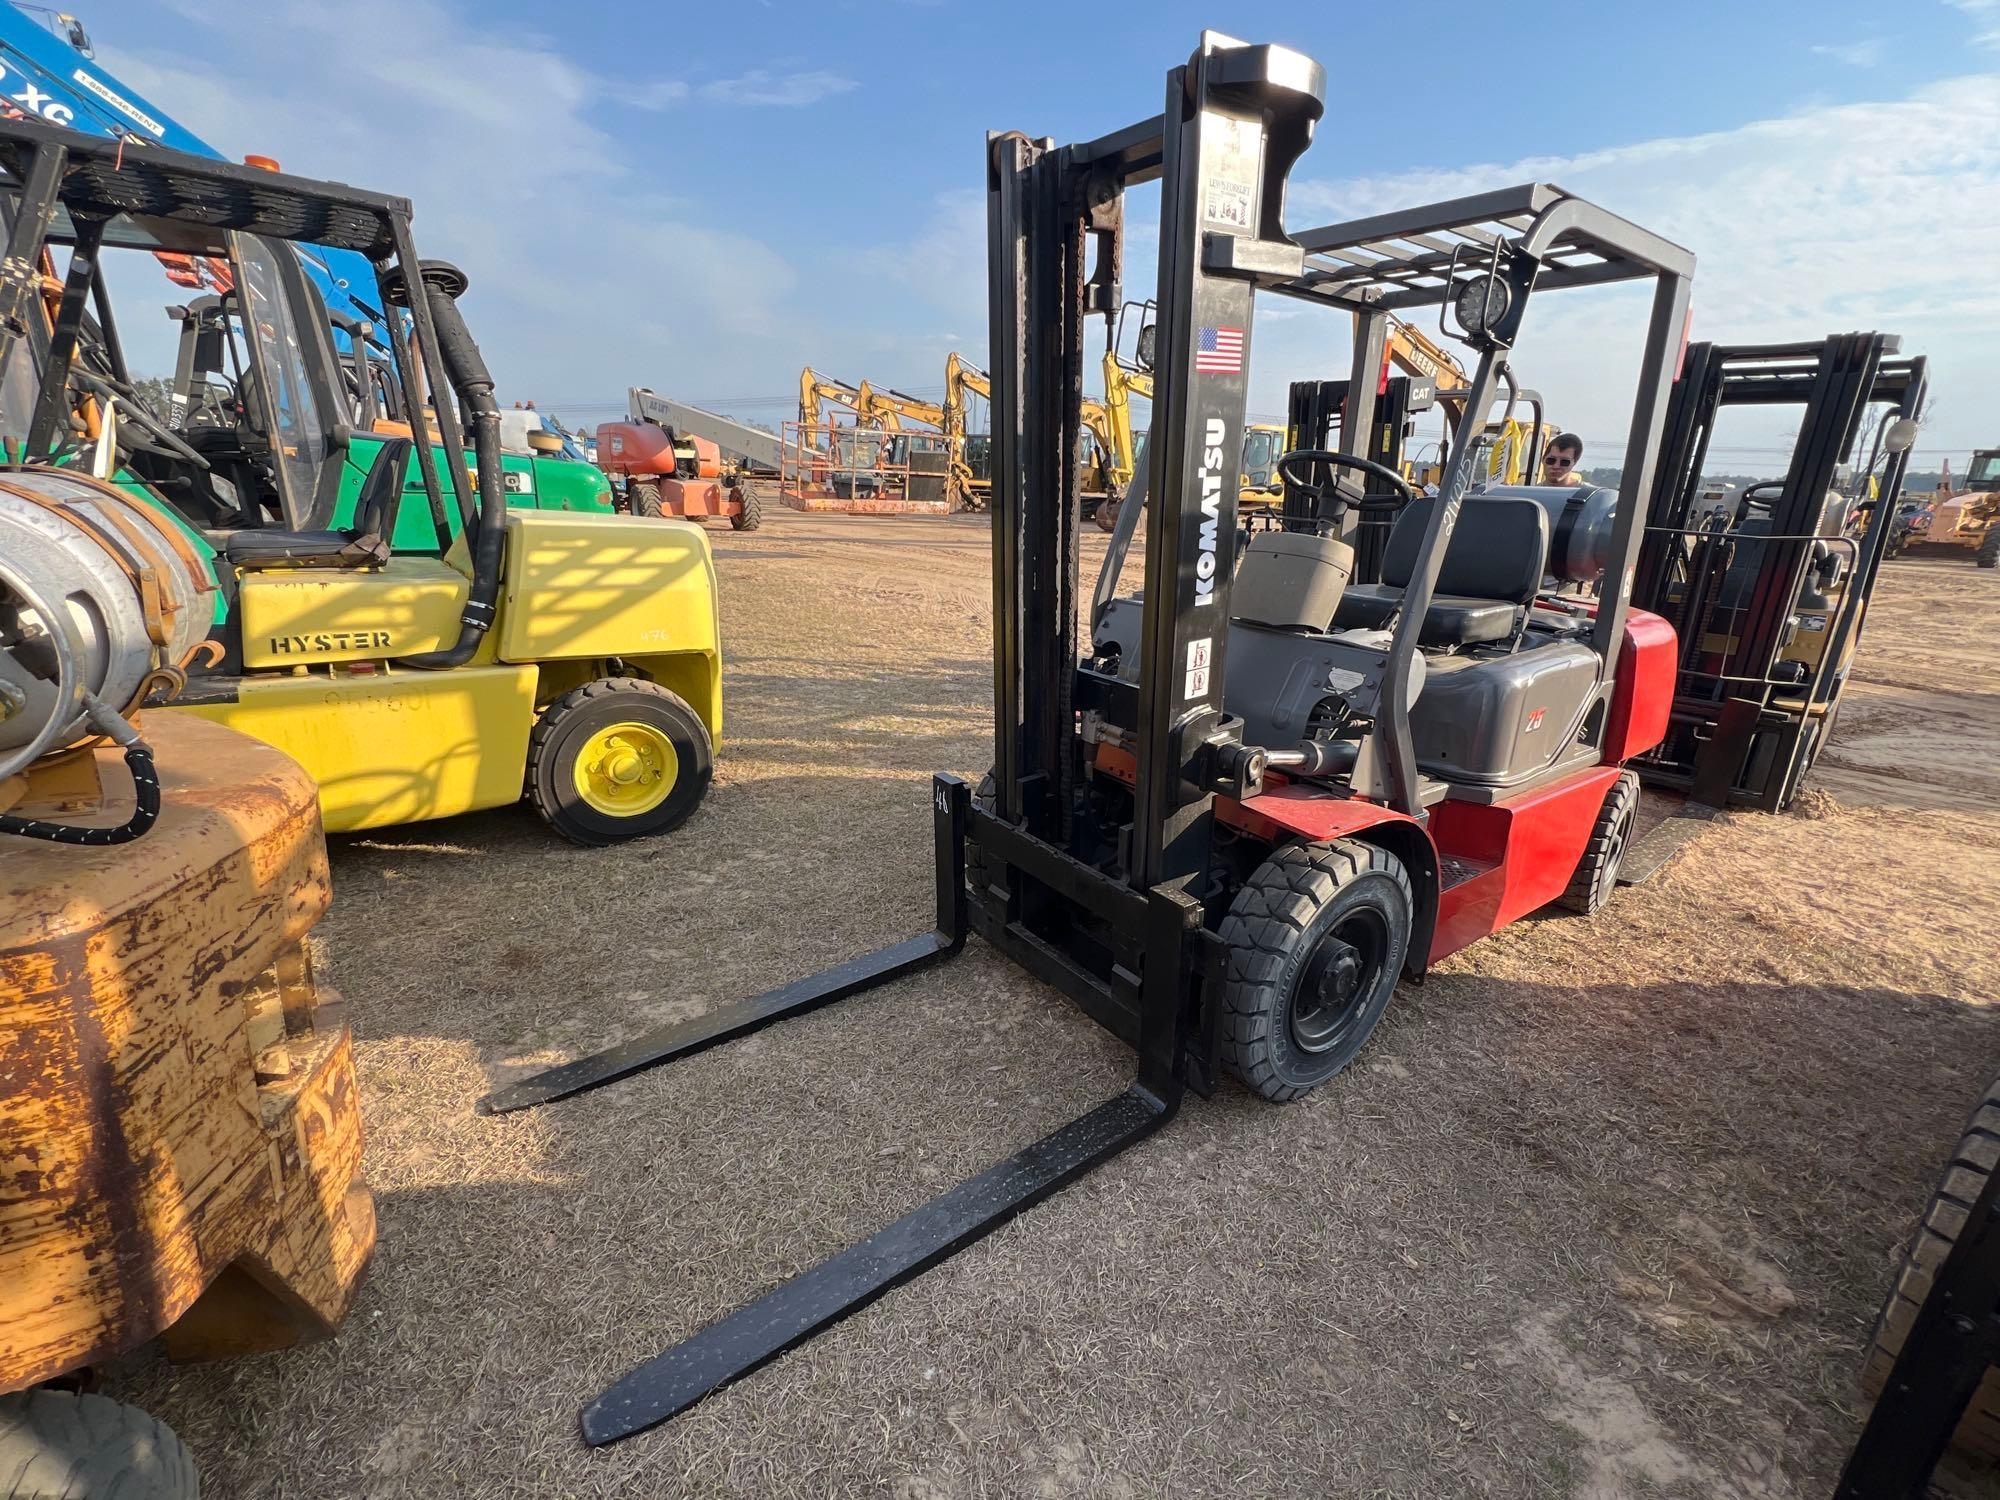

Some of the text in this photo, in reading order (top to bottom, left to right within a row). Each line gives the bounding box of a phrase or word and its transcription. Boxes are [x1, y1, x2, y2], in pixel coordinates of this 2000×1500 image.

[11, 82, 74, 126] XC
[841, 392, 853, 405] CAT
[1412, 387, 1430, 401] CAT
[1443, 452, 1472, 536] 211095
[1194, 418, 1226, 606] KOMATSU
[270, 631, 391, 654] HYSTER
